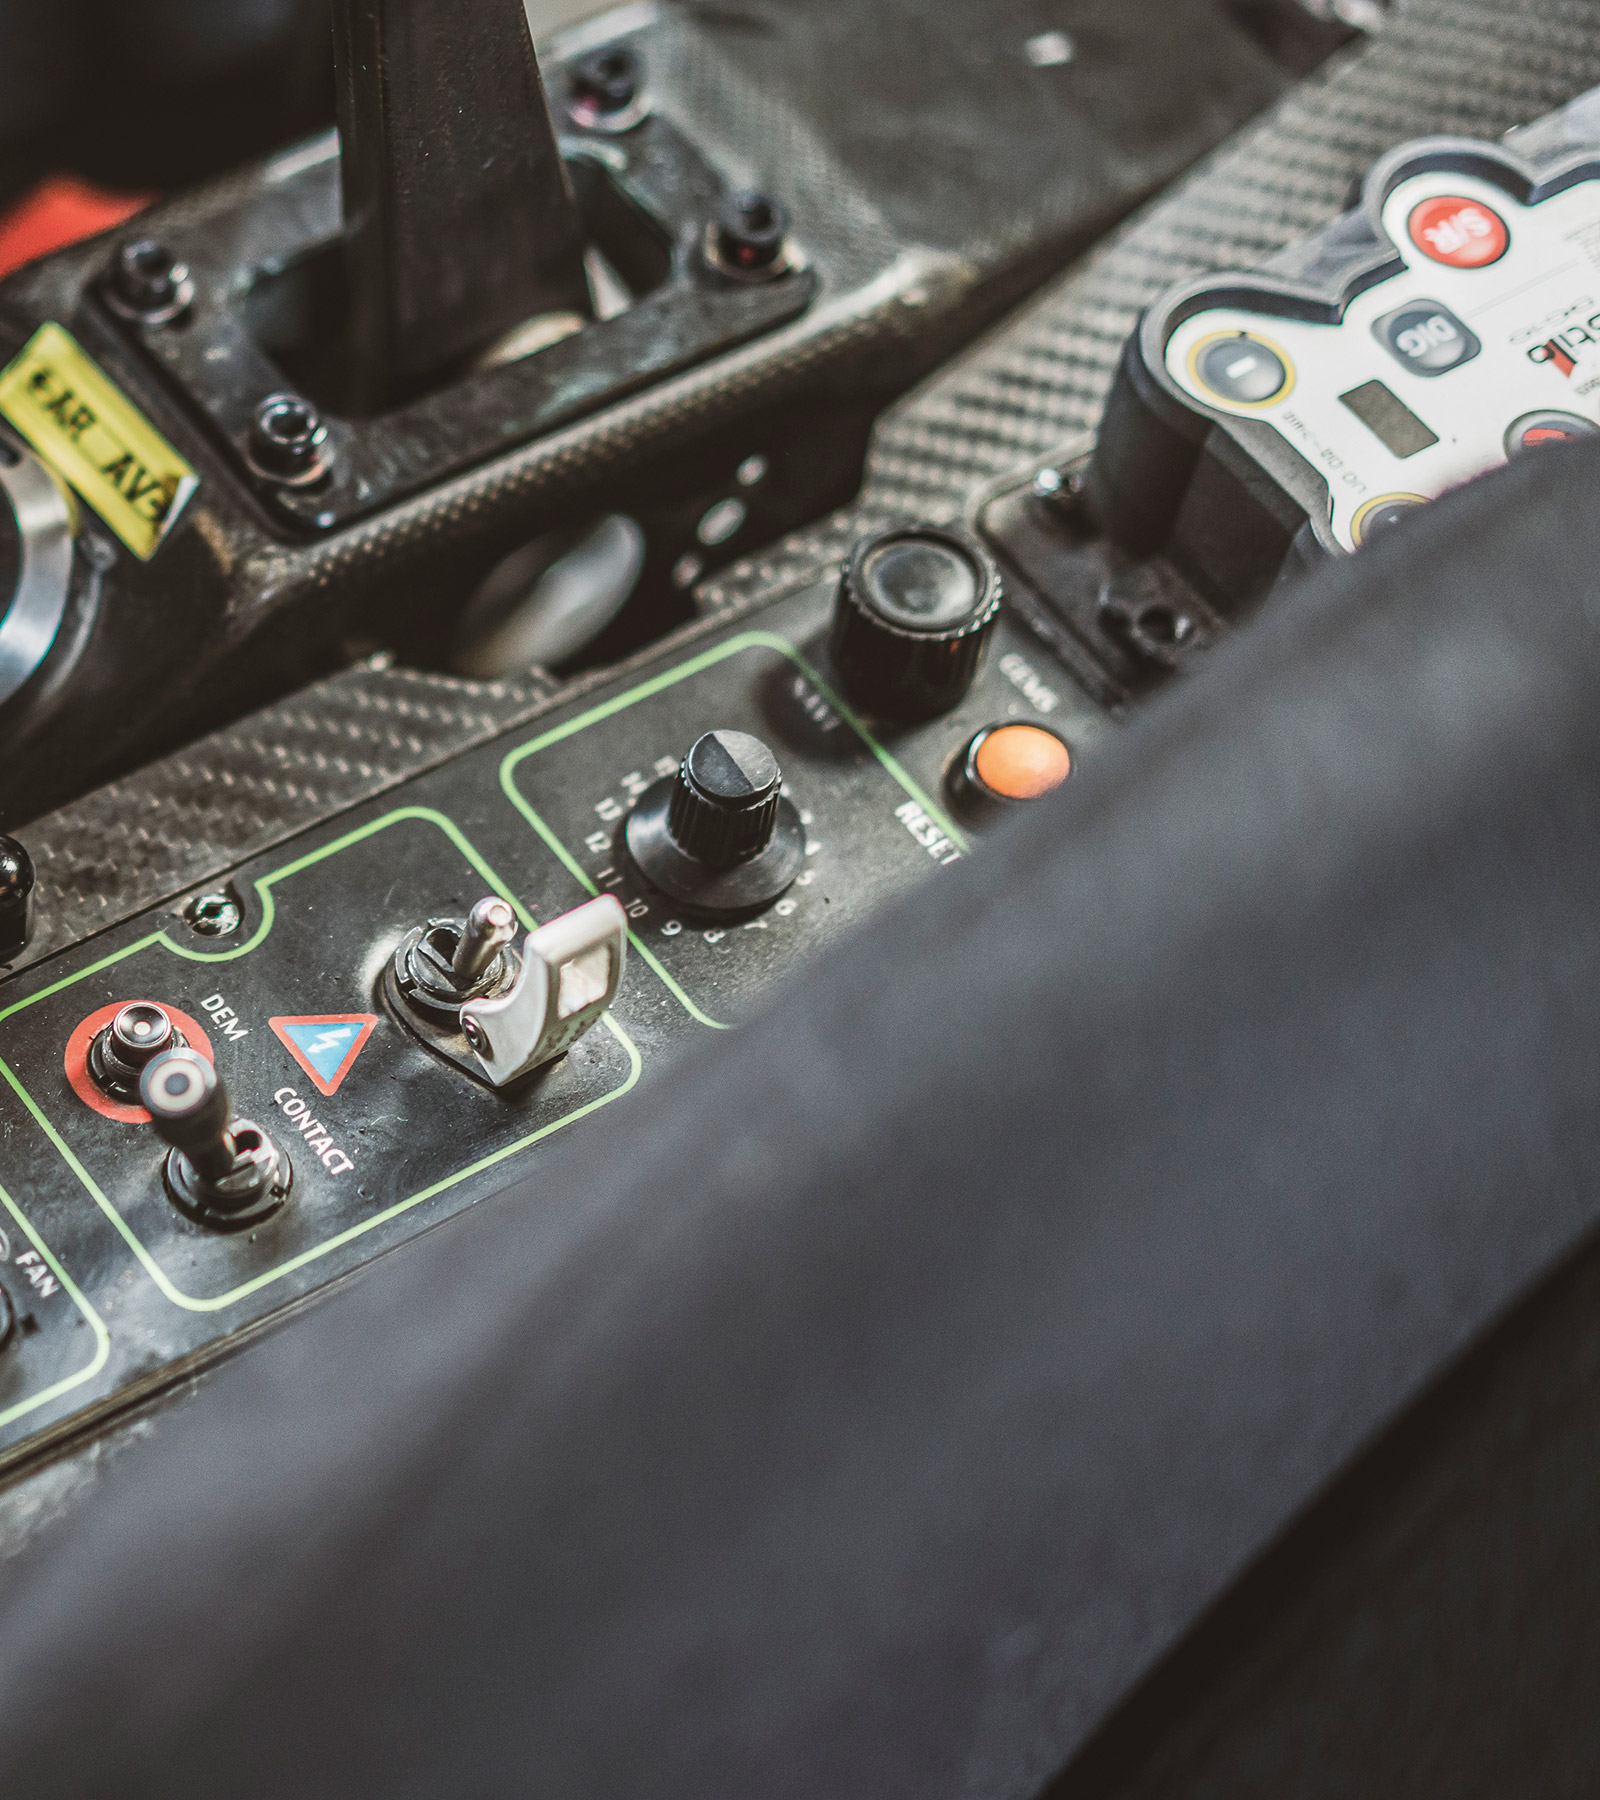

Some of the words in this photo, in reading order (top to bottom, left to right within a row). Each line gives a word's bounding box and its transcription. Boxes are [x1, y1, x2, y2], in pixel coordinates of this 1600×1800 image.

[1396, 314, 1459, 359] DIG
[894, 800, 965, 866] RESET
[625, 898, 649, 919] 10
[660, 919, 683, 937] 9
[774, 898, 798, 917] 6
[703, 928, 726, 944] 8
[200, 993, 249, 1042] DEM
[273, 1086, 355, 1176] CONTACT
[14, 1250, 60, 1298] FAN
